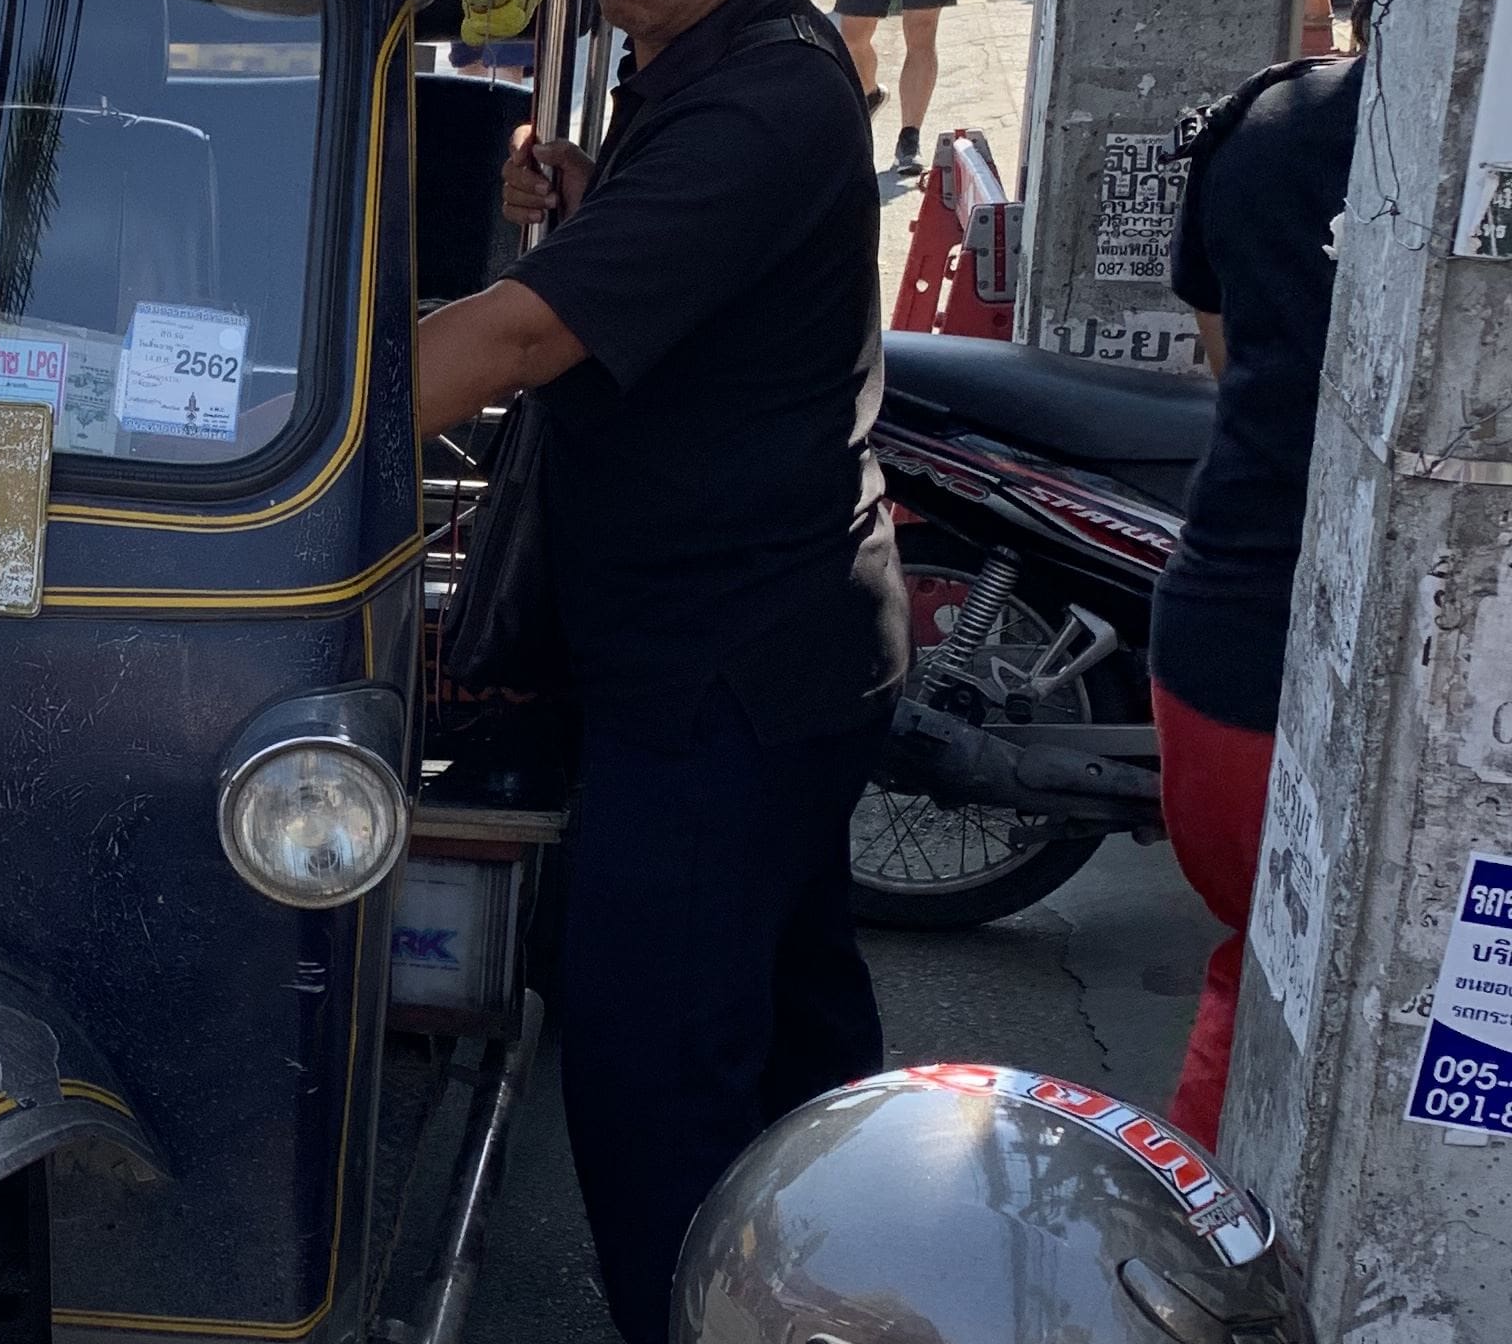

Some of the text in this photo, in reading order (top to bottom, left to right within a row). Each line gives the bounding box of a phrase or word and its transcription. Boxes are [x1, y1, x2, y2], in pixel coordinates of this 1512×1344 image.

[26, 349, 59, 379] LPG
[173, 349, 239, 383] 2562
[1027, 485, 1176, 551] SPARK
